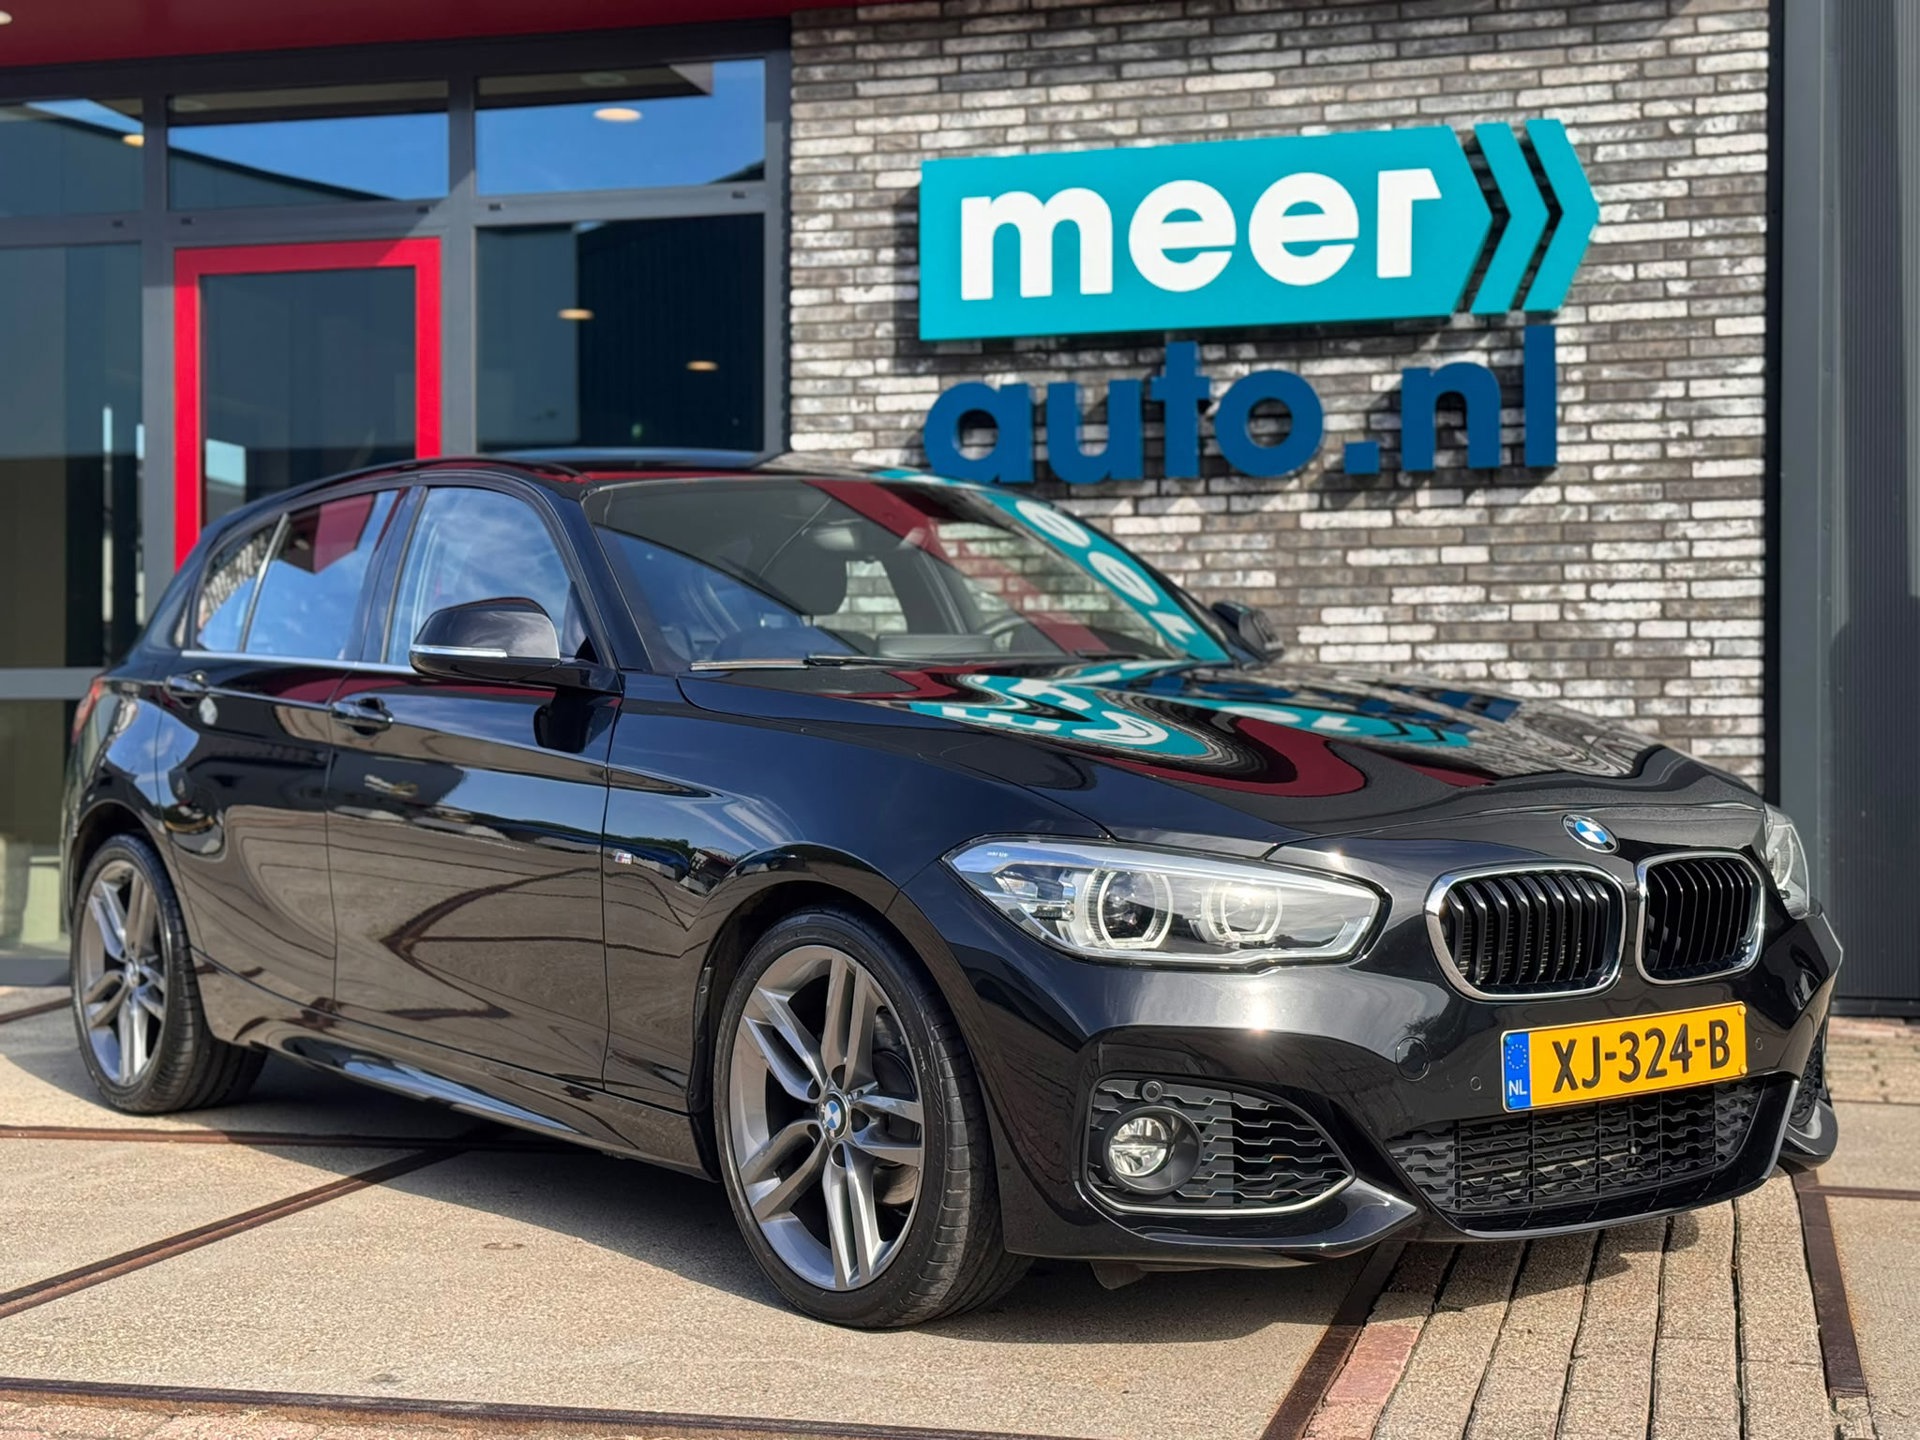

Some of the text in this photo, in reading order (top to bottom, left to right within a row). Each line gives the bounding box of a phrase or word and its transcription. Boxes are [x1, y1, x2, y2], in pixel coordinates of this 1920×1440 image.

[961, 167, 1442, 300] meer
[923, 324, 1557, 485] auto.nl
[1508, 1079, 1528, 1097] NL
[1552, 1019, 1731, 1094] XJ-324-B
